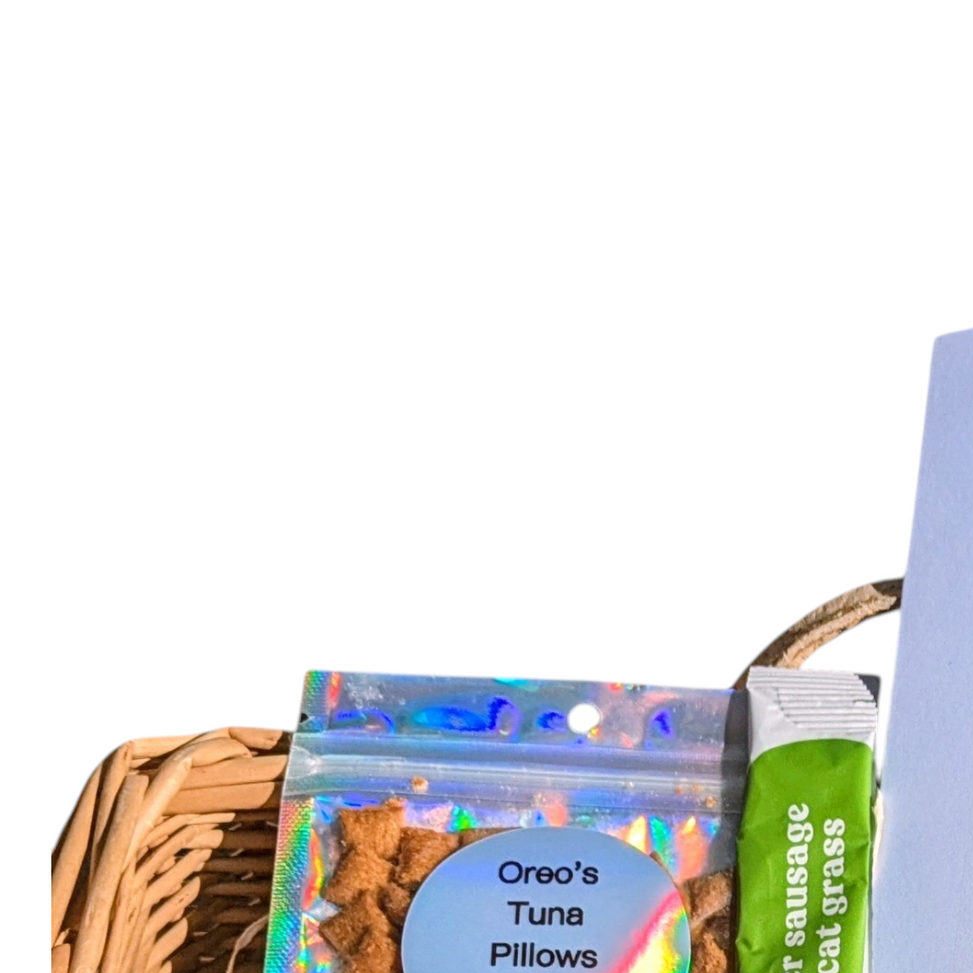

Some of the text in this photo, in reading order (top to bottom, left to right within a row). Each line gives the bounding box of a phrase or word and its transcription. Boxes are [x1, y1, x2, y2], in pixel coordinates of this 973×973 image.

[498, 860, 599, 885] Oreo's
[784, 802, 815, 947] sausage
[821, 817, 849, 917] grass
[507, 900, 584, 926] Tuna
[490, 942, 599, 969] Pillows
